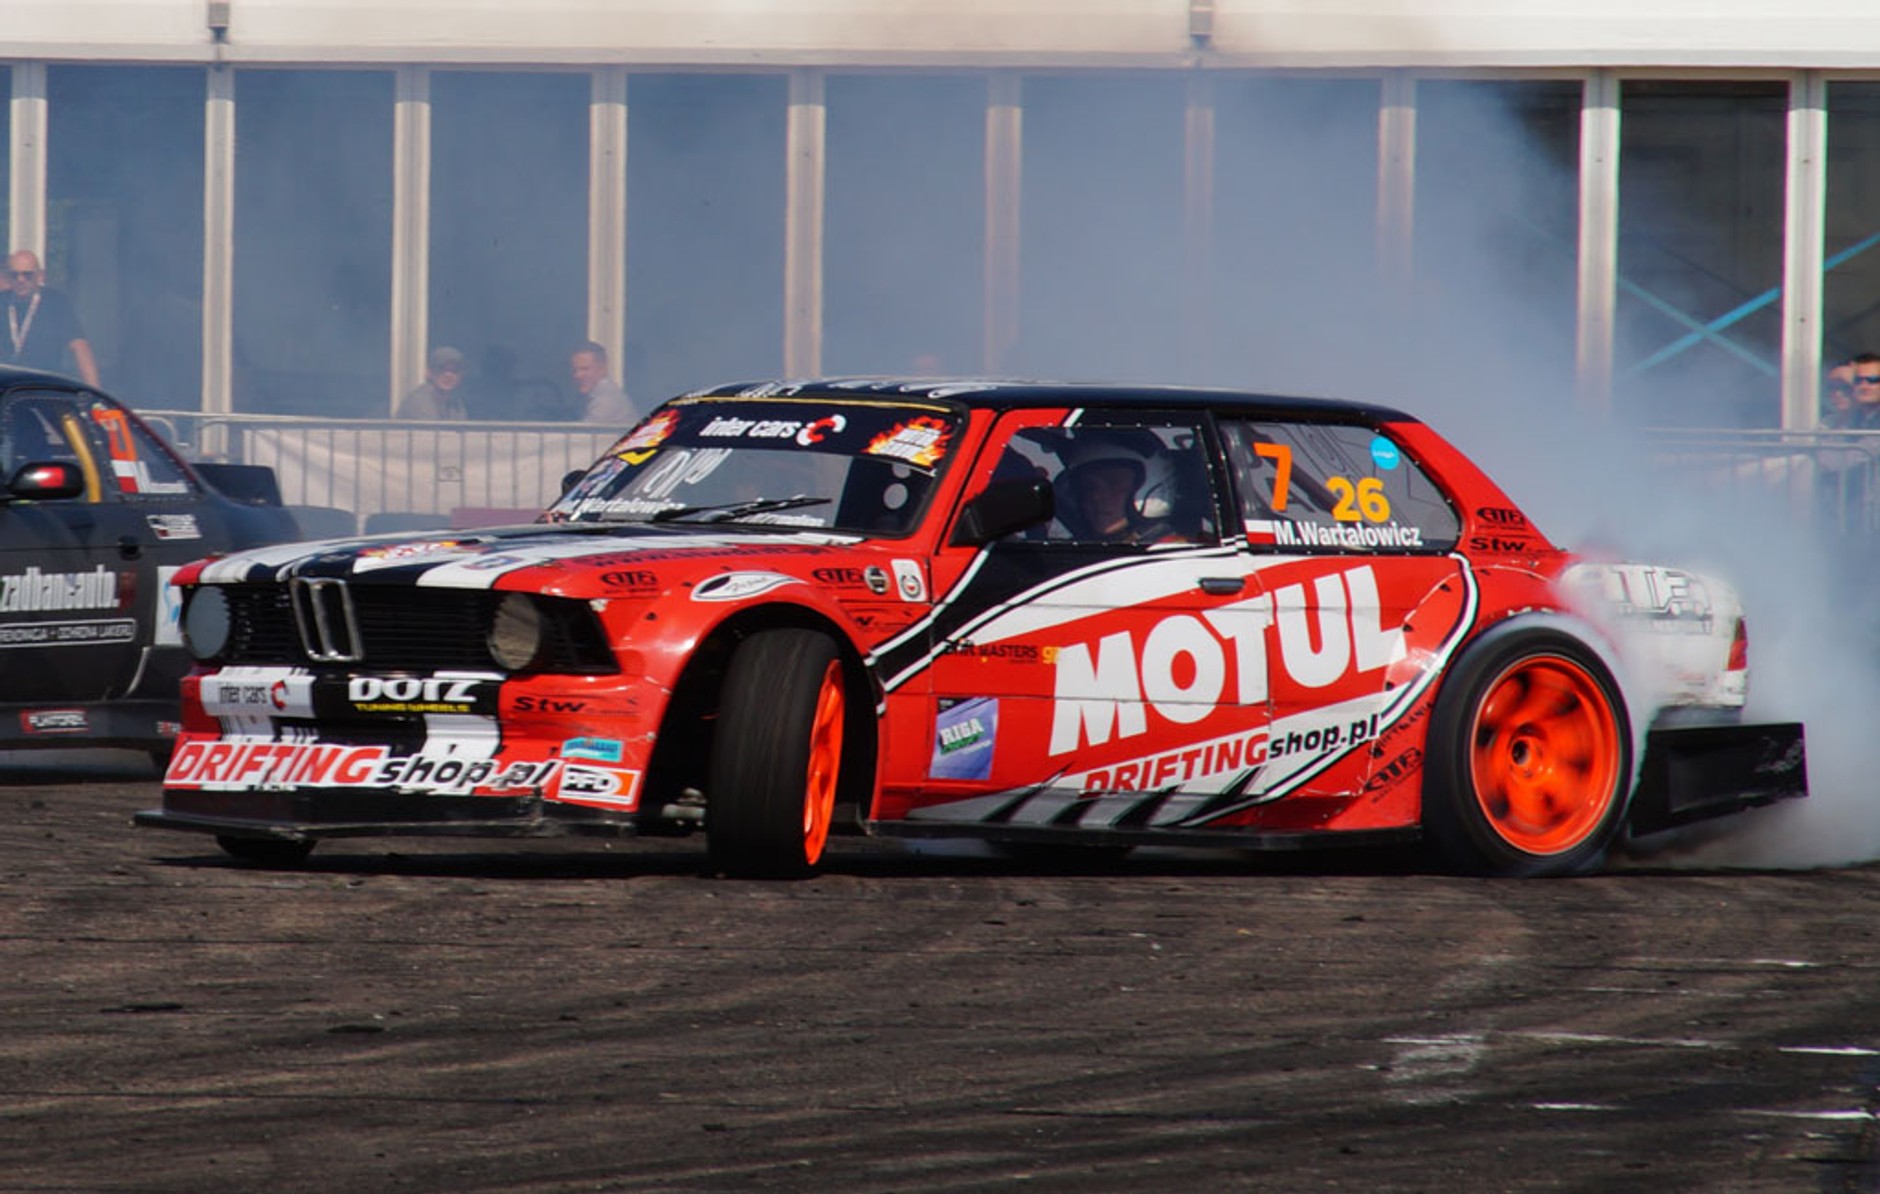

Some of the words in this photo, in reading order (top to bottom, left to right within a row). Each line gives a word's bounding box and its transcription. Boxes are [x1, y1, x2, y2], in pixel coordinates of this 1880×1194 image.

[699, 416, 754, 437] inter
[749, 419, 801, 438] cars
[1253, 441, 1292, 512] 7
[1325, 476, 1391, 523] 26
[1049, 565, 1407, 757] MOTUL
[349, 678, 482, 702] DOTZ
